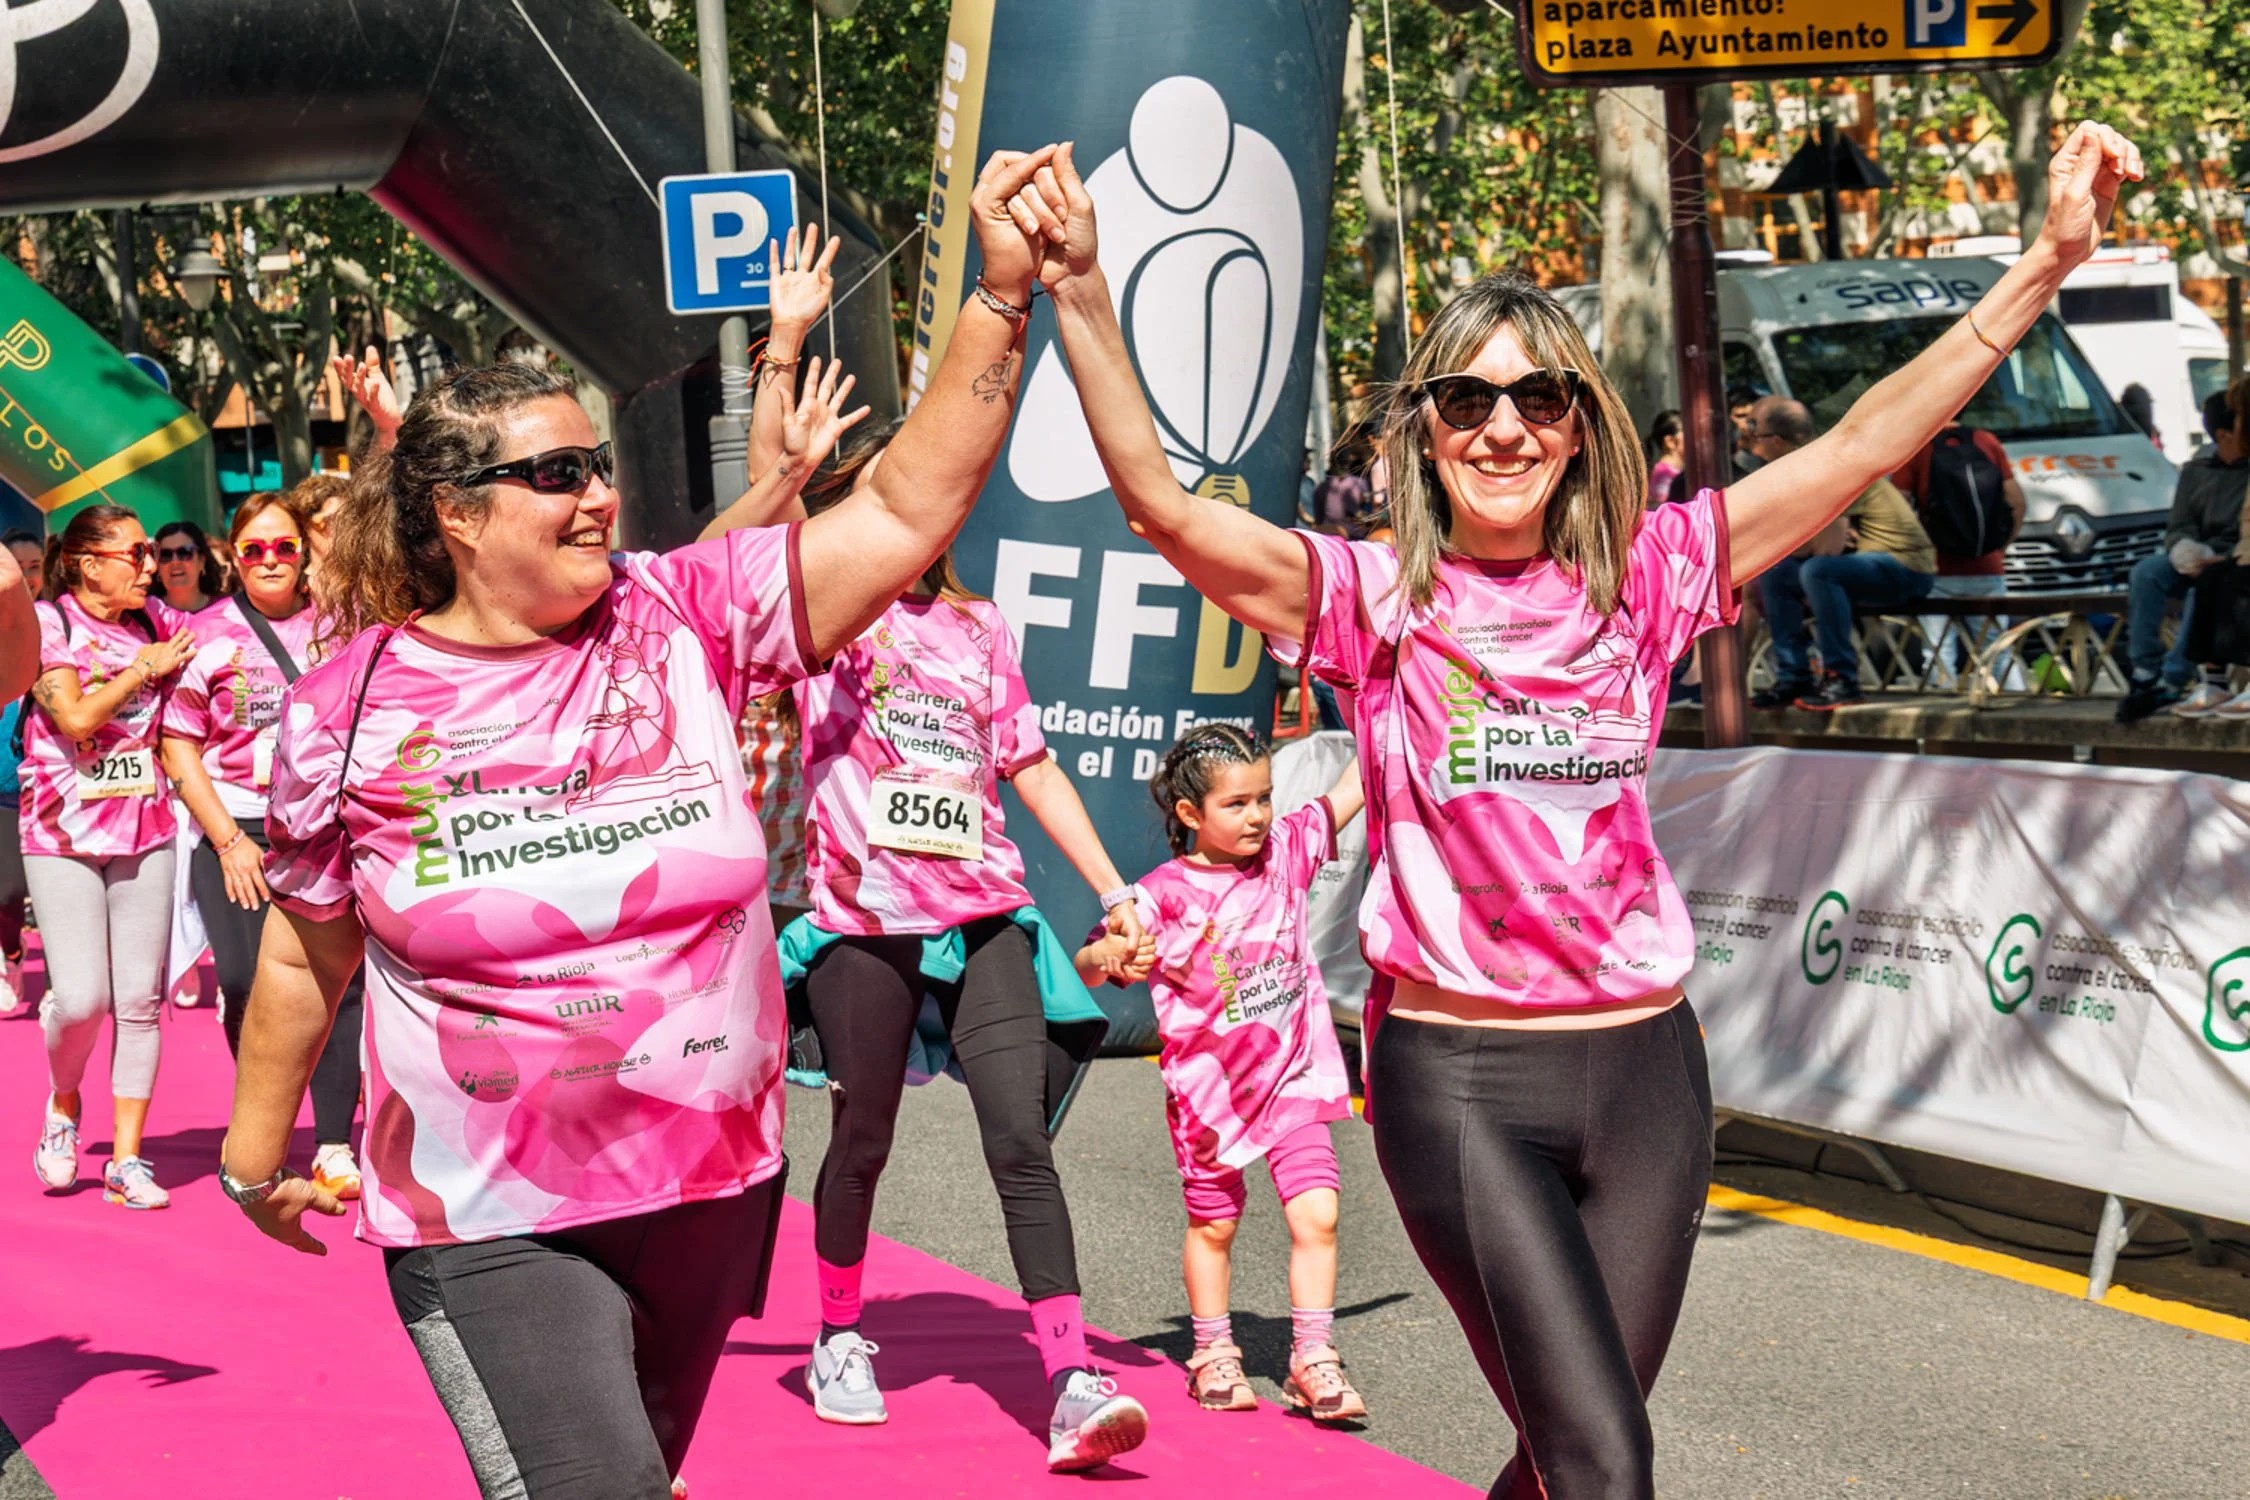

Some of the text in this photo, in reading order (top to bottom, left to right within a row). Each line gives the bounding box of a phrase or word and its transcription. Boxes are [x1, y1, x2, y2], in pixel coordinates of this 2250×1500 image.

[1544, 0, 1785, 28] aparcamiento:
[1546, 22, 1888, 66] plaza Ayuntamiento
[690, 190, 769, 295] P
[892, 683, 963, 713] Carrera
[447, 721, 512, 738] asociación
[887, 708, 940, 731] por la
[450, 737, 489, 751] contra
[1485, 724, 1573, 751] por la
[91, 756, 142, 782] 9215
[1078, 747, 1115, 778] el
[887, 790, 970, 834] 8564
[450, 810, 515, 847] por
[460, 799, 711, 878] Investigación
[1540, 881, 1569, 895] Rioja
[537, 960, 597, 985] La Rioja
[1234, 954, 1286, 982] Carrera
[2045, 961, 2092, 986] contra
[2096, 964, 2111, 987] el
[1239, 977, 1278, 1003] por la
[2038, 992, 2116, 1026] en La Rioja
